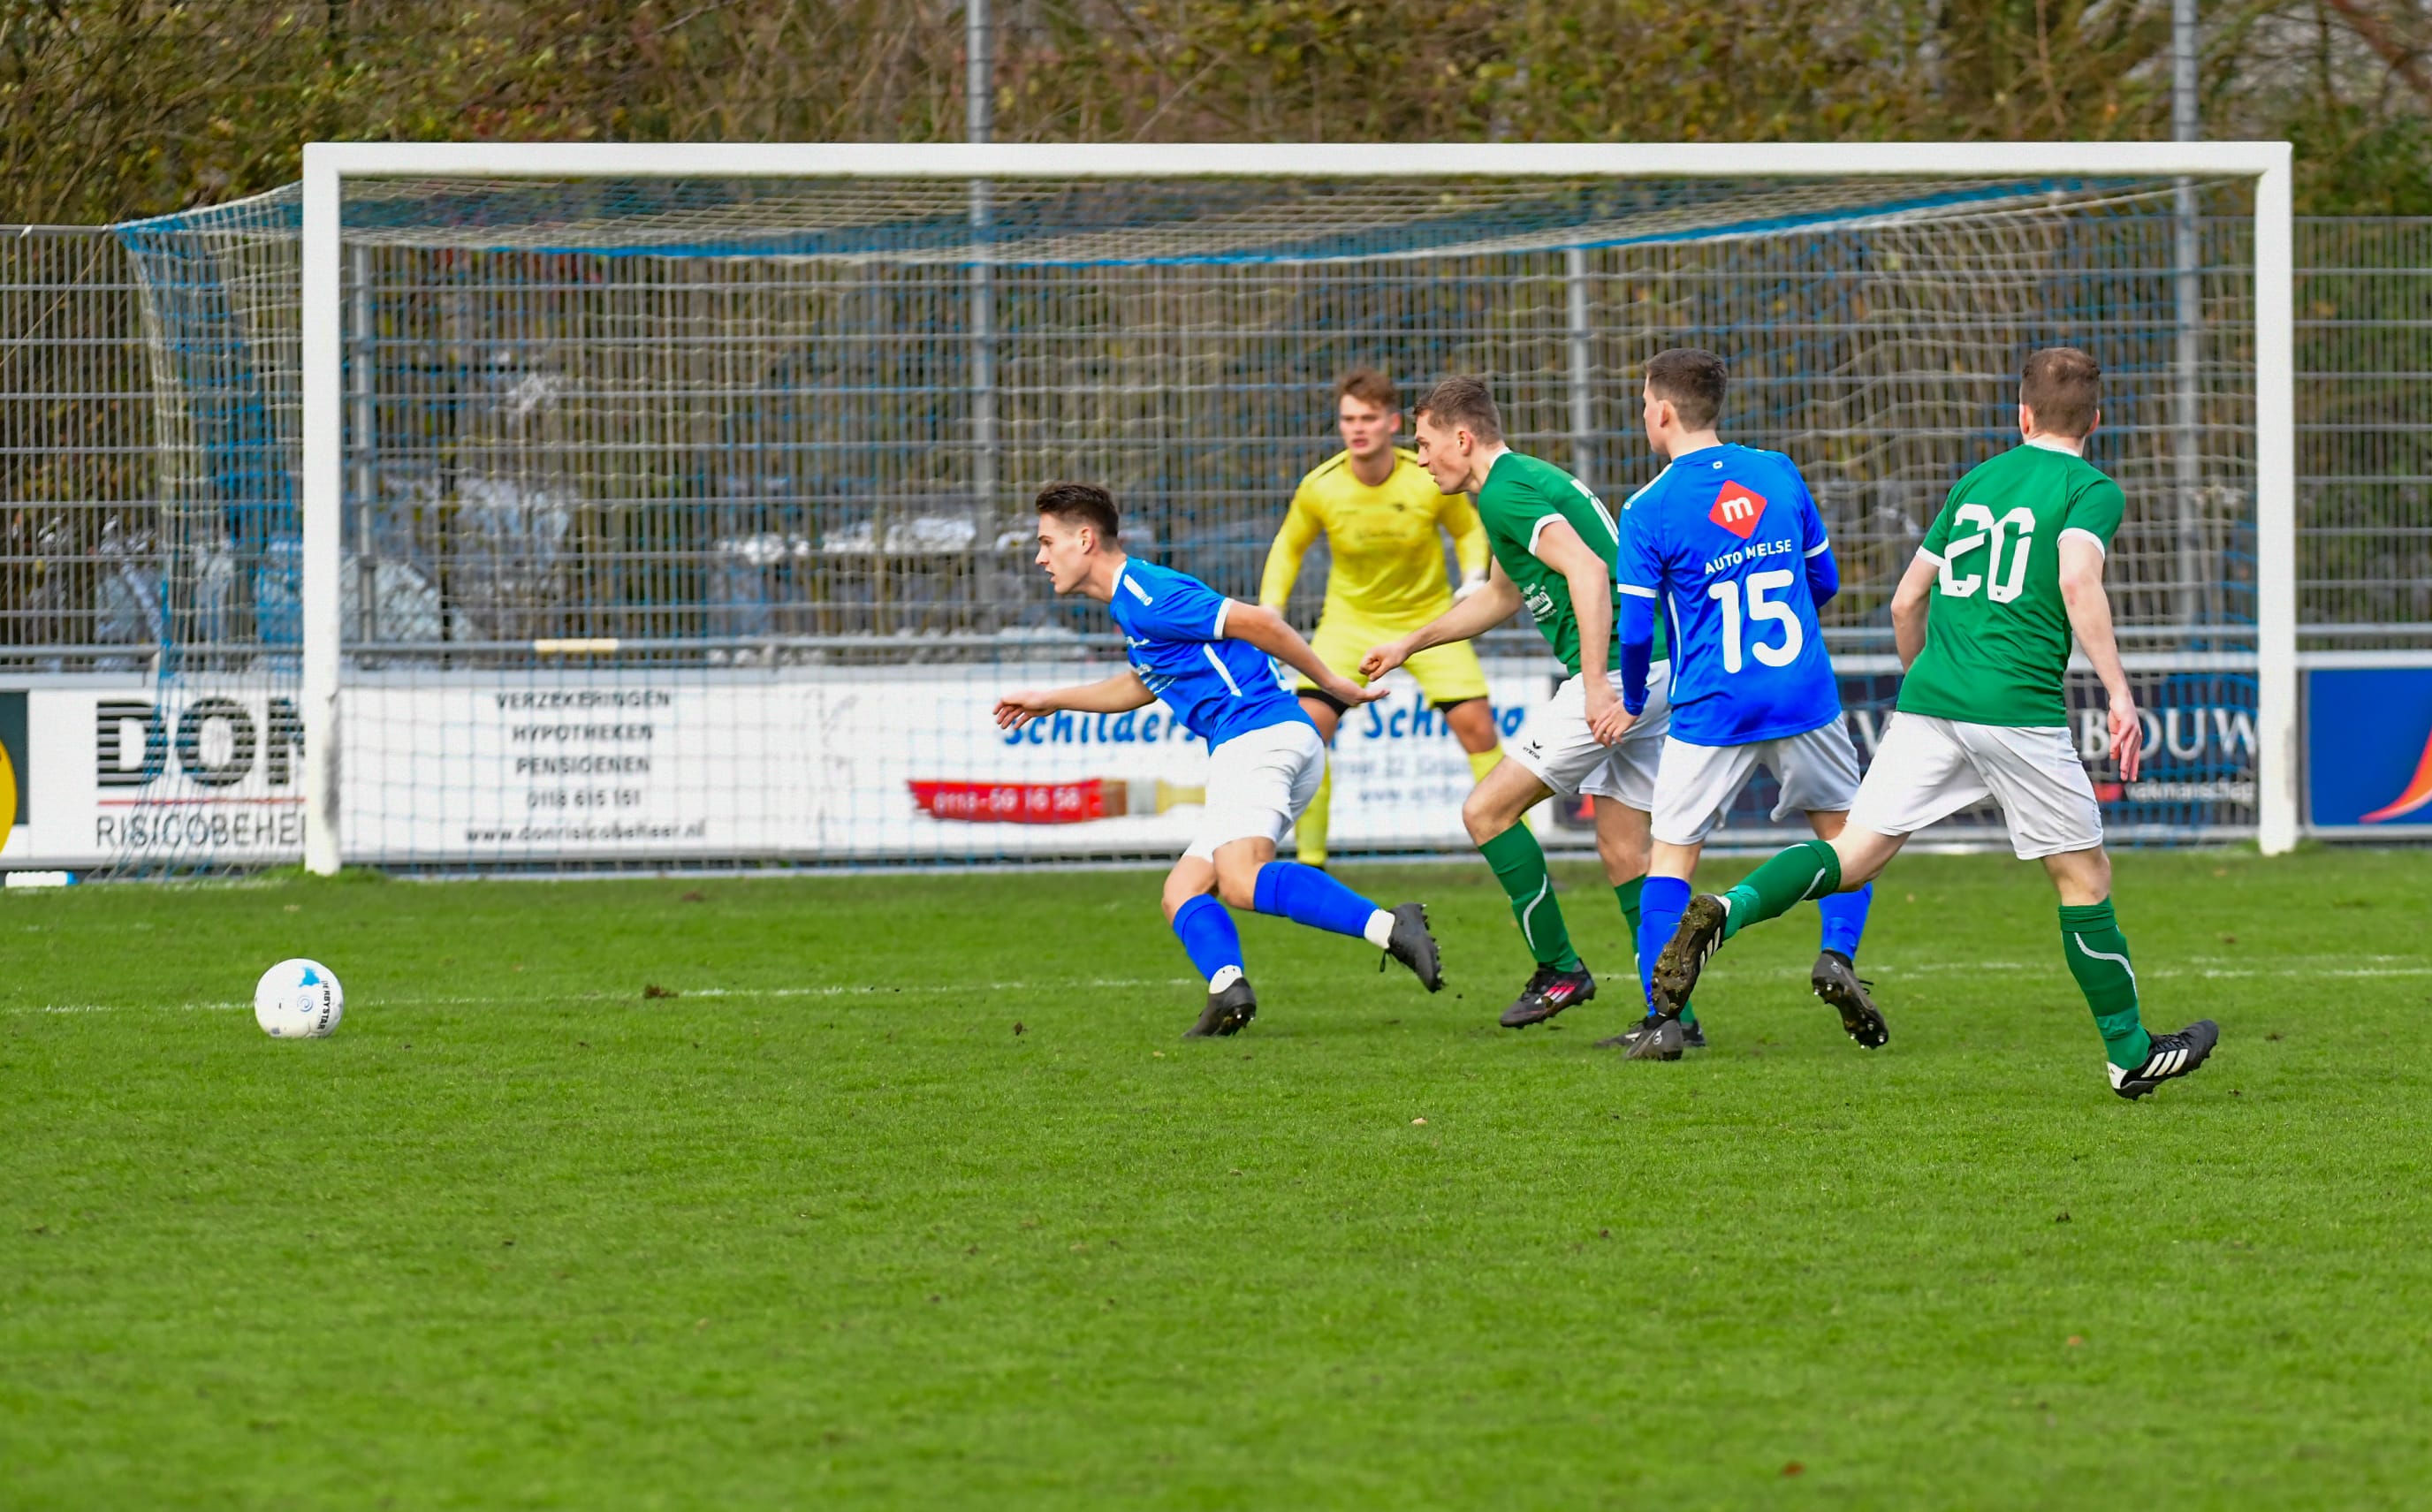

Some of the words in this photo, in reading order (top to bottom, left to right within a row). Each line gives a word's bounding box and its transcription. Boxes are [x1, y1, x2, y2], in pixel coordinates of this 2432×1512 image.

[1721, 496, 1754, 523] m
[1705, 551, 1744, 575] AUTO
[1745, 539, 1792, 559] MELSE
[1939, 503, 2036, 604] 20
[1707, 569, 1803, 674] 15
[496, 692, 671, 709] VERZEKERINGEN
[513, 724, 653, 742] HYPOTHEKEN
[96, 814, 306, 847] RISICOBEHE
